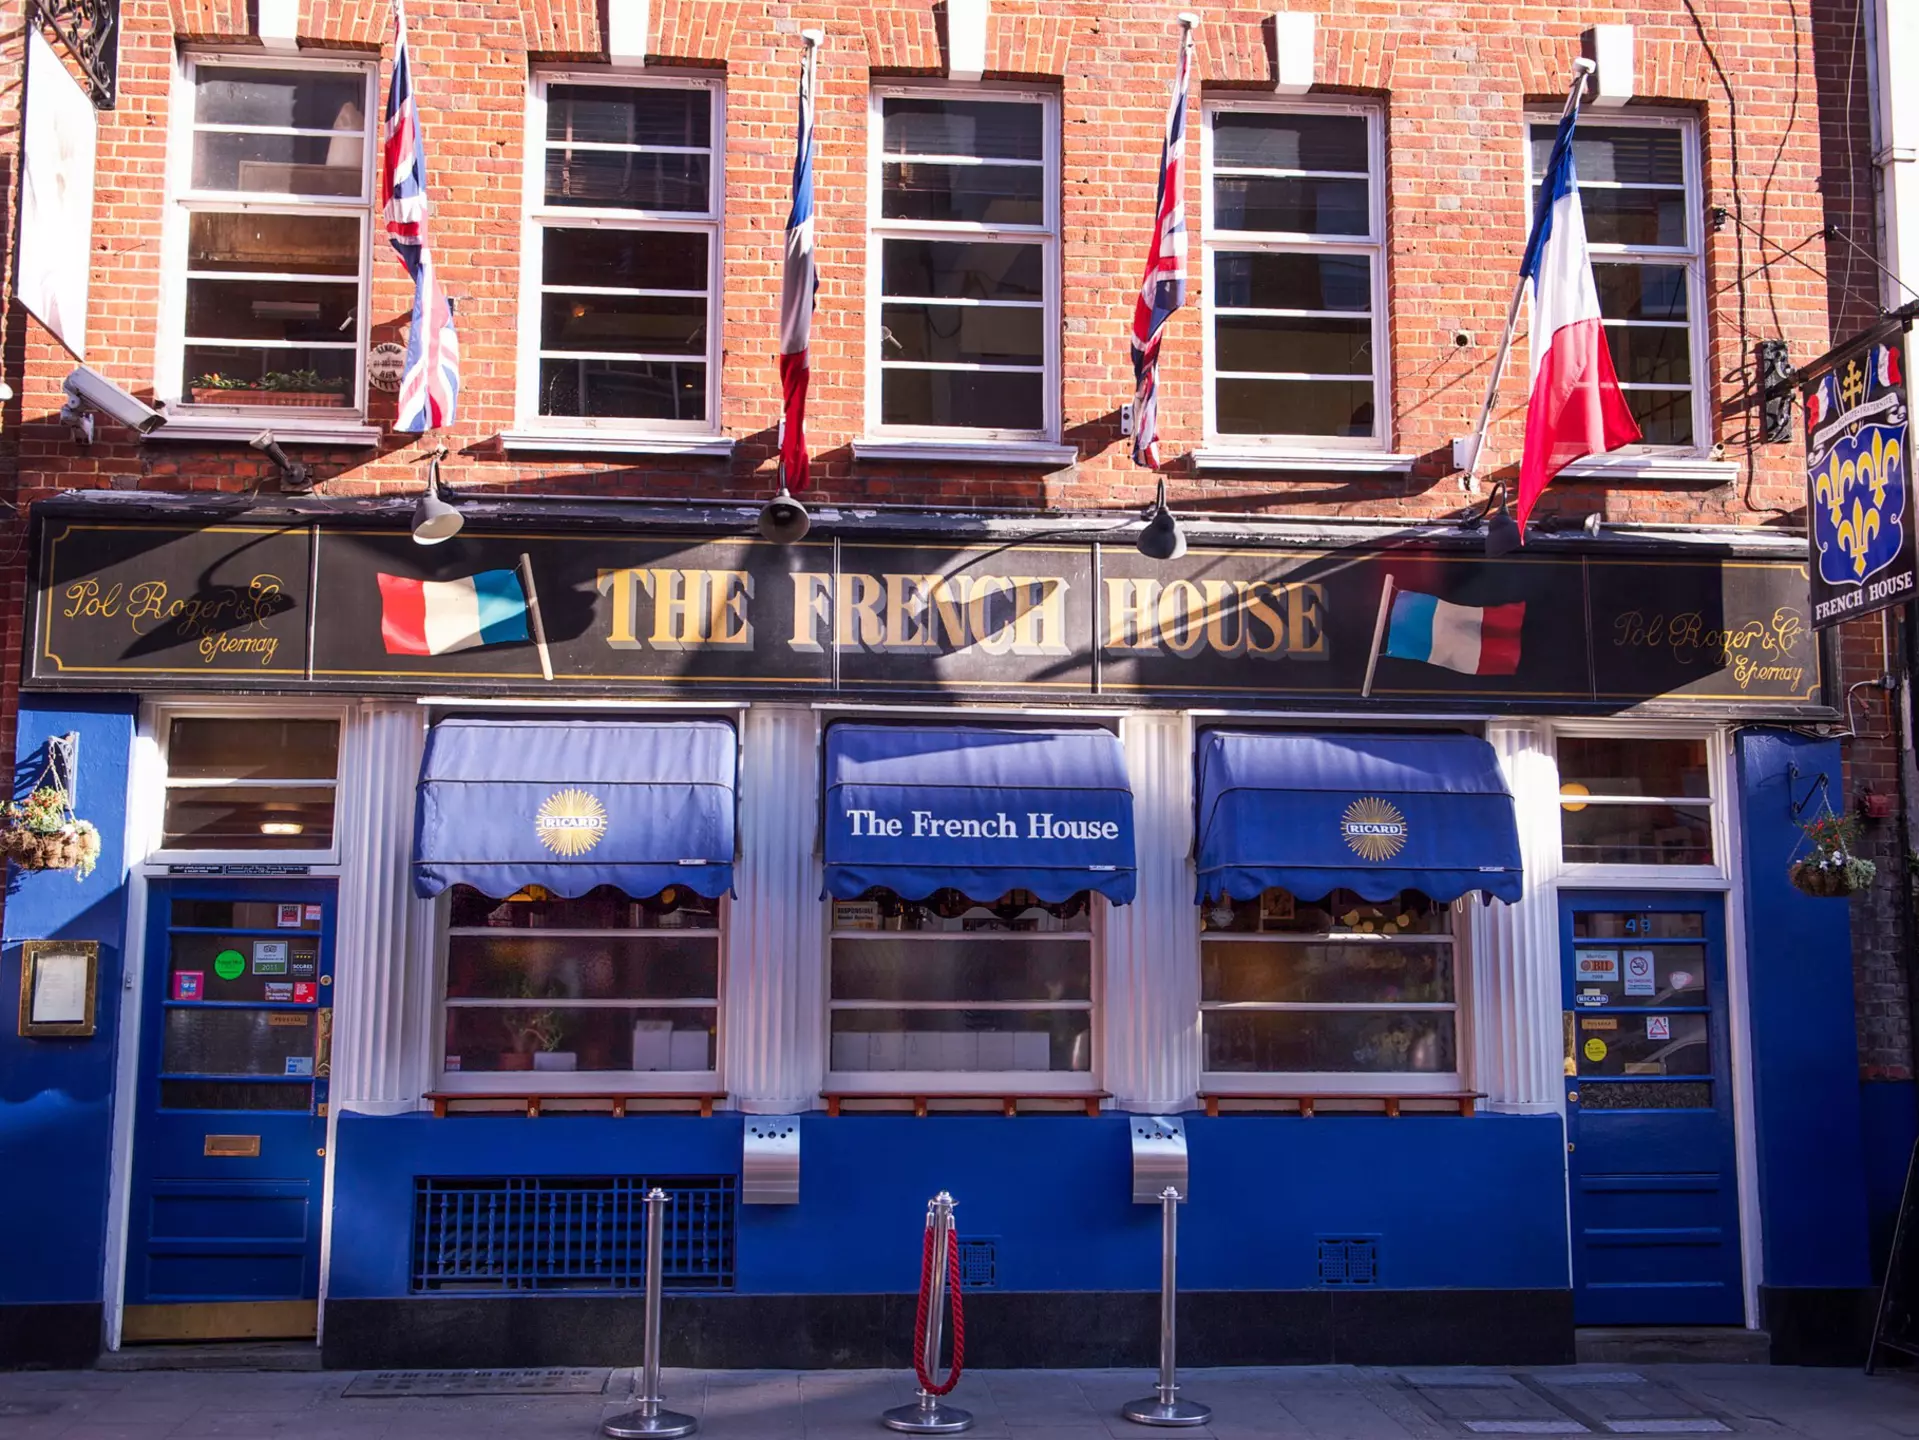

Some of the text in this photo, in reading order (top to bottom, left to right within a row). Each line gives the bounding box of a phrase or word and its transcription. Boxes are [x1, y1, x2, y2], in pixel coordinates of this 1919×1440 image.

[63, 577, 122, 620] Pol
[126, 580, 237, 636] Roger
[597, 568, 1330, 662] THE FRENCH HOUSE
[1815, 571, 1913, 620] FRENCH HOUSE
[199, 626, 279, 665] Epernay
[1613, 608, 1664, 647] Pol
[1668, 610, 1764, 667] Roger
[1733, 655, 1804, 692] Epernay
[544, 817, 600, 829] RICARD
[847, 809, 1119, 840] The French House
[1350, 824, 1400, 834] RICARD
